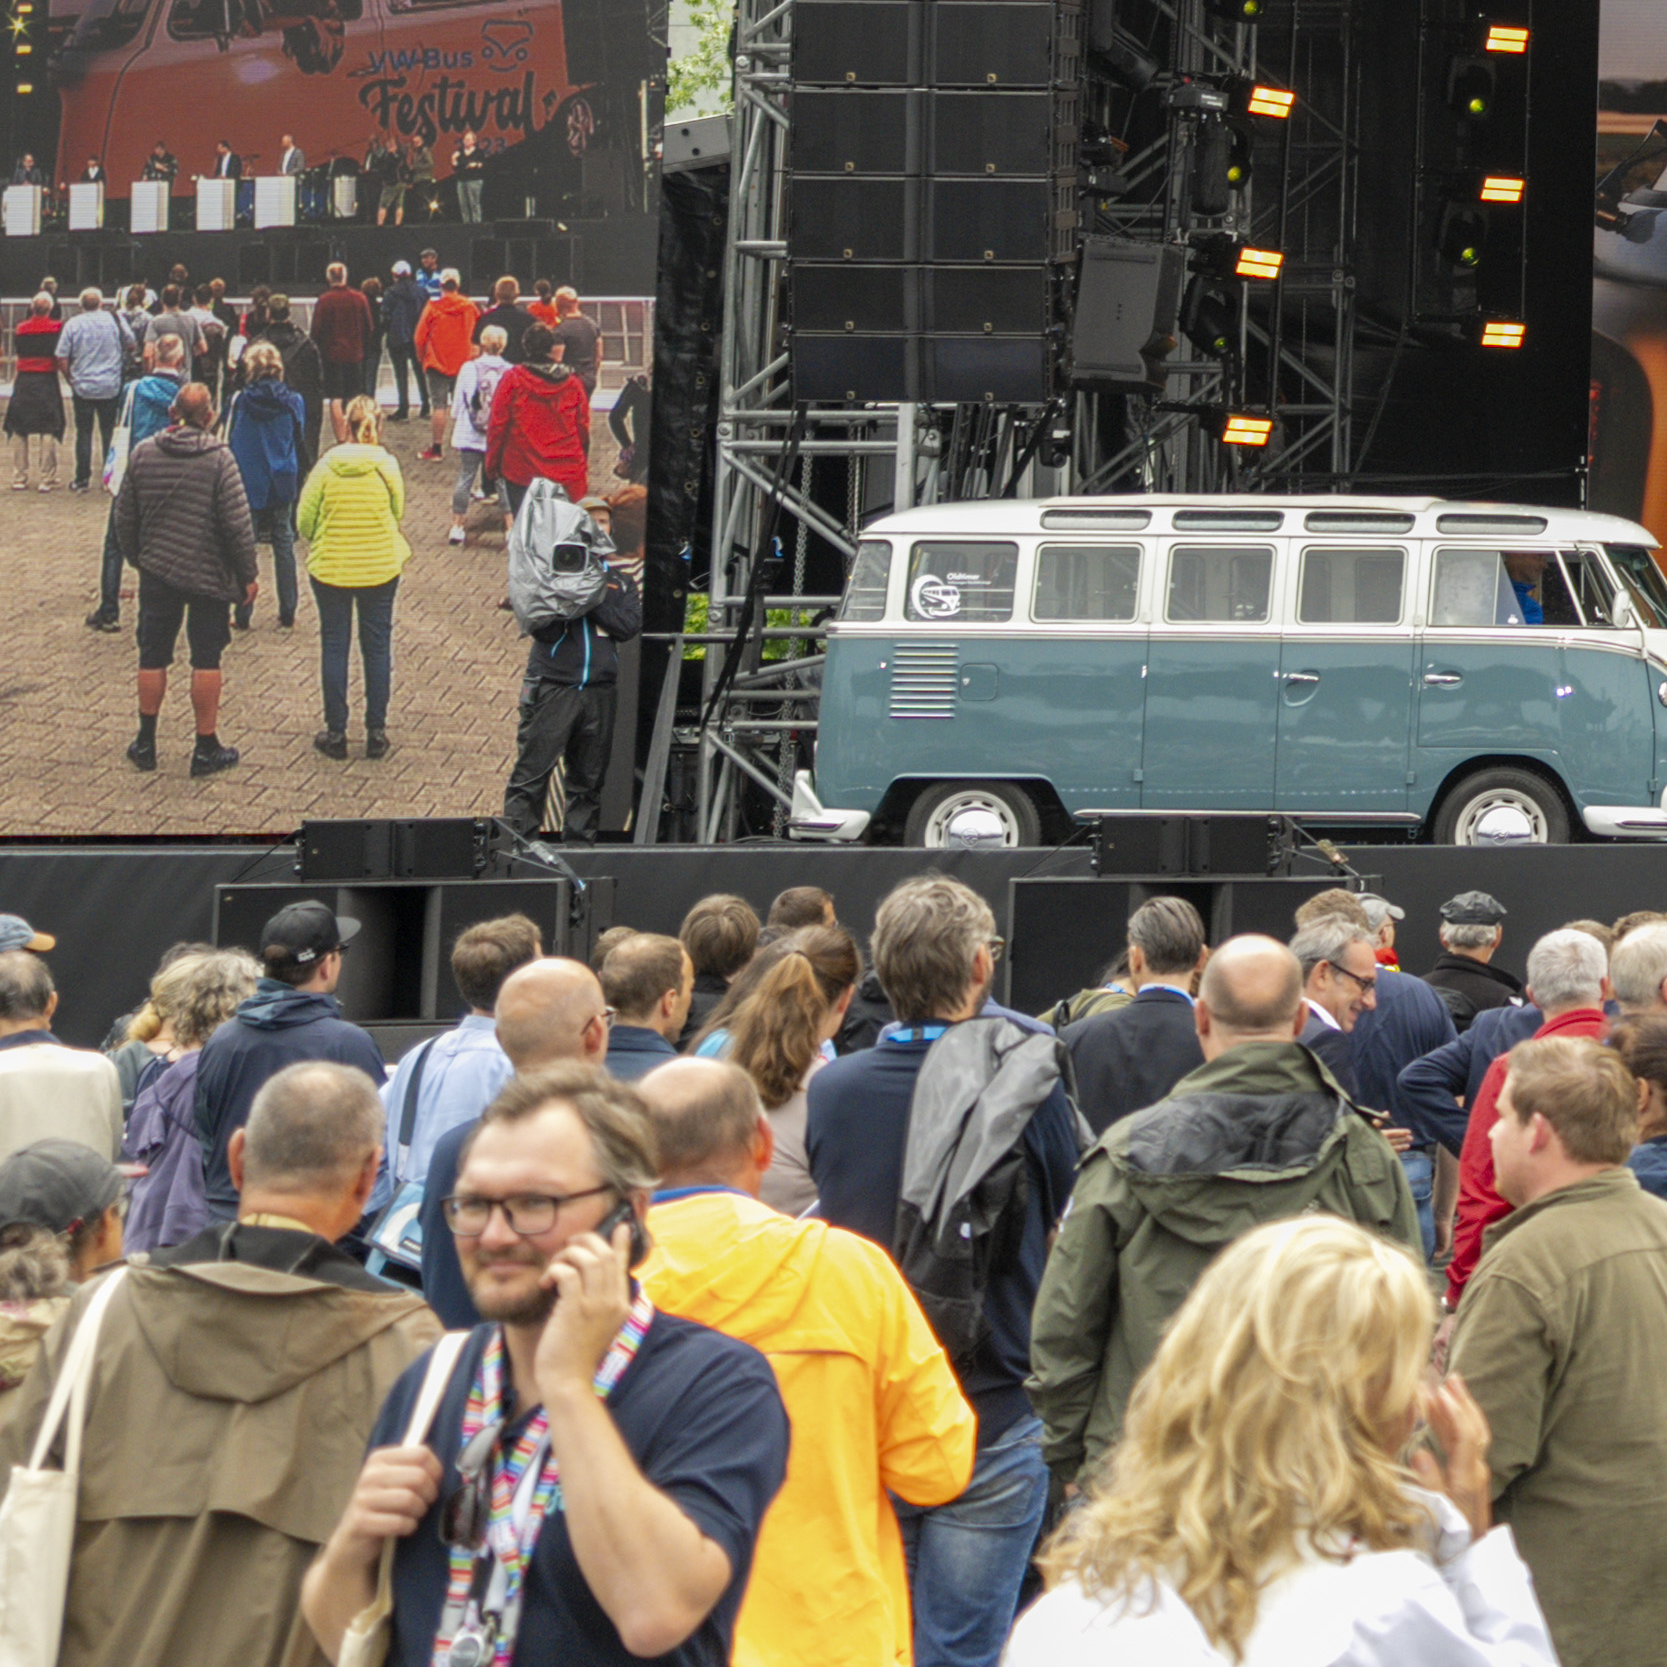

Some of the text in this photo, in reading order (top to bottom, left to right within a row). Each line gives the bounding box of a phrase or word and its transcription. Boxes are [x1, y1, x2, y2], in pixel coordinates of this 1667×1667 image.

[368, 48, 474, 72] VW Bus
[358, 70, 558, 150] Festival
